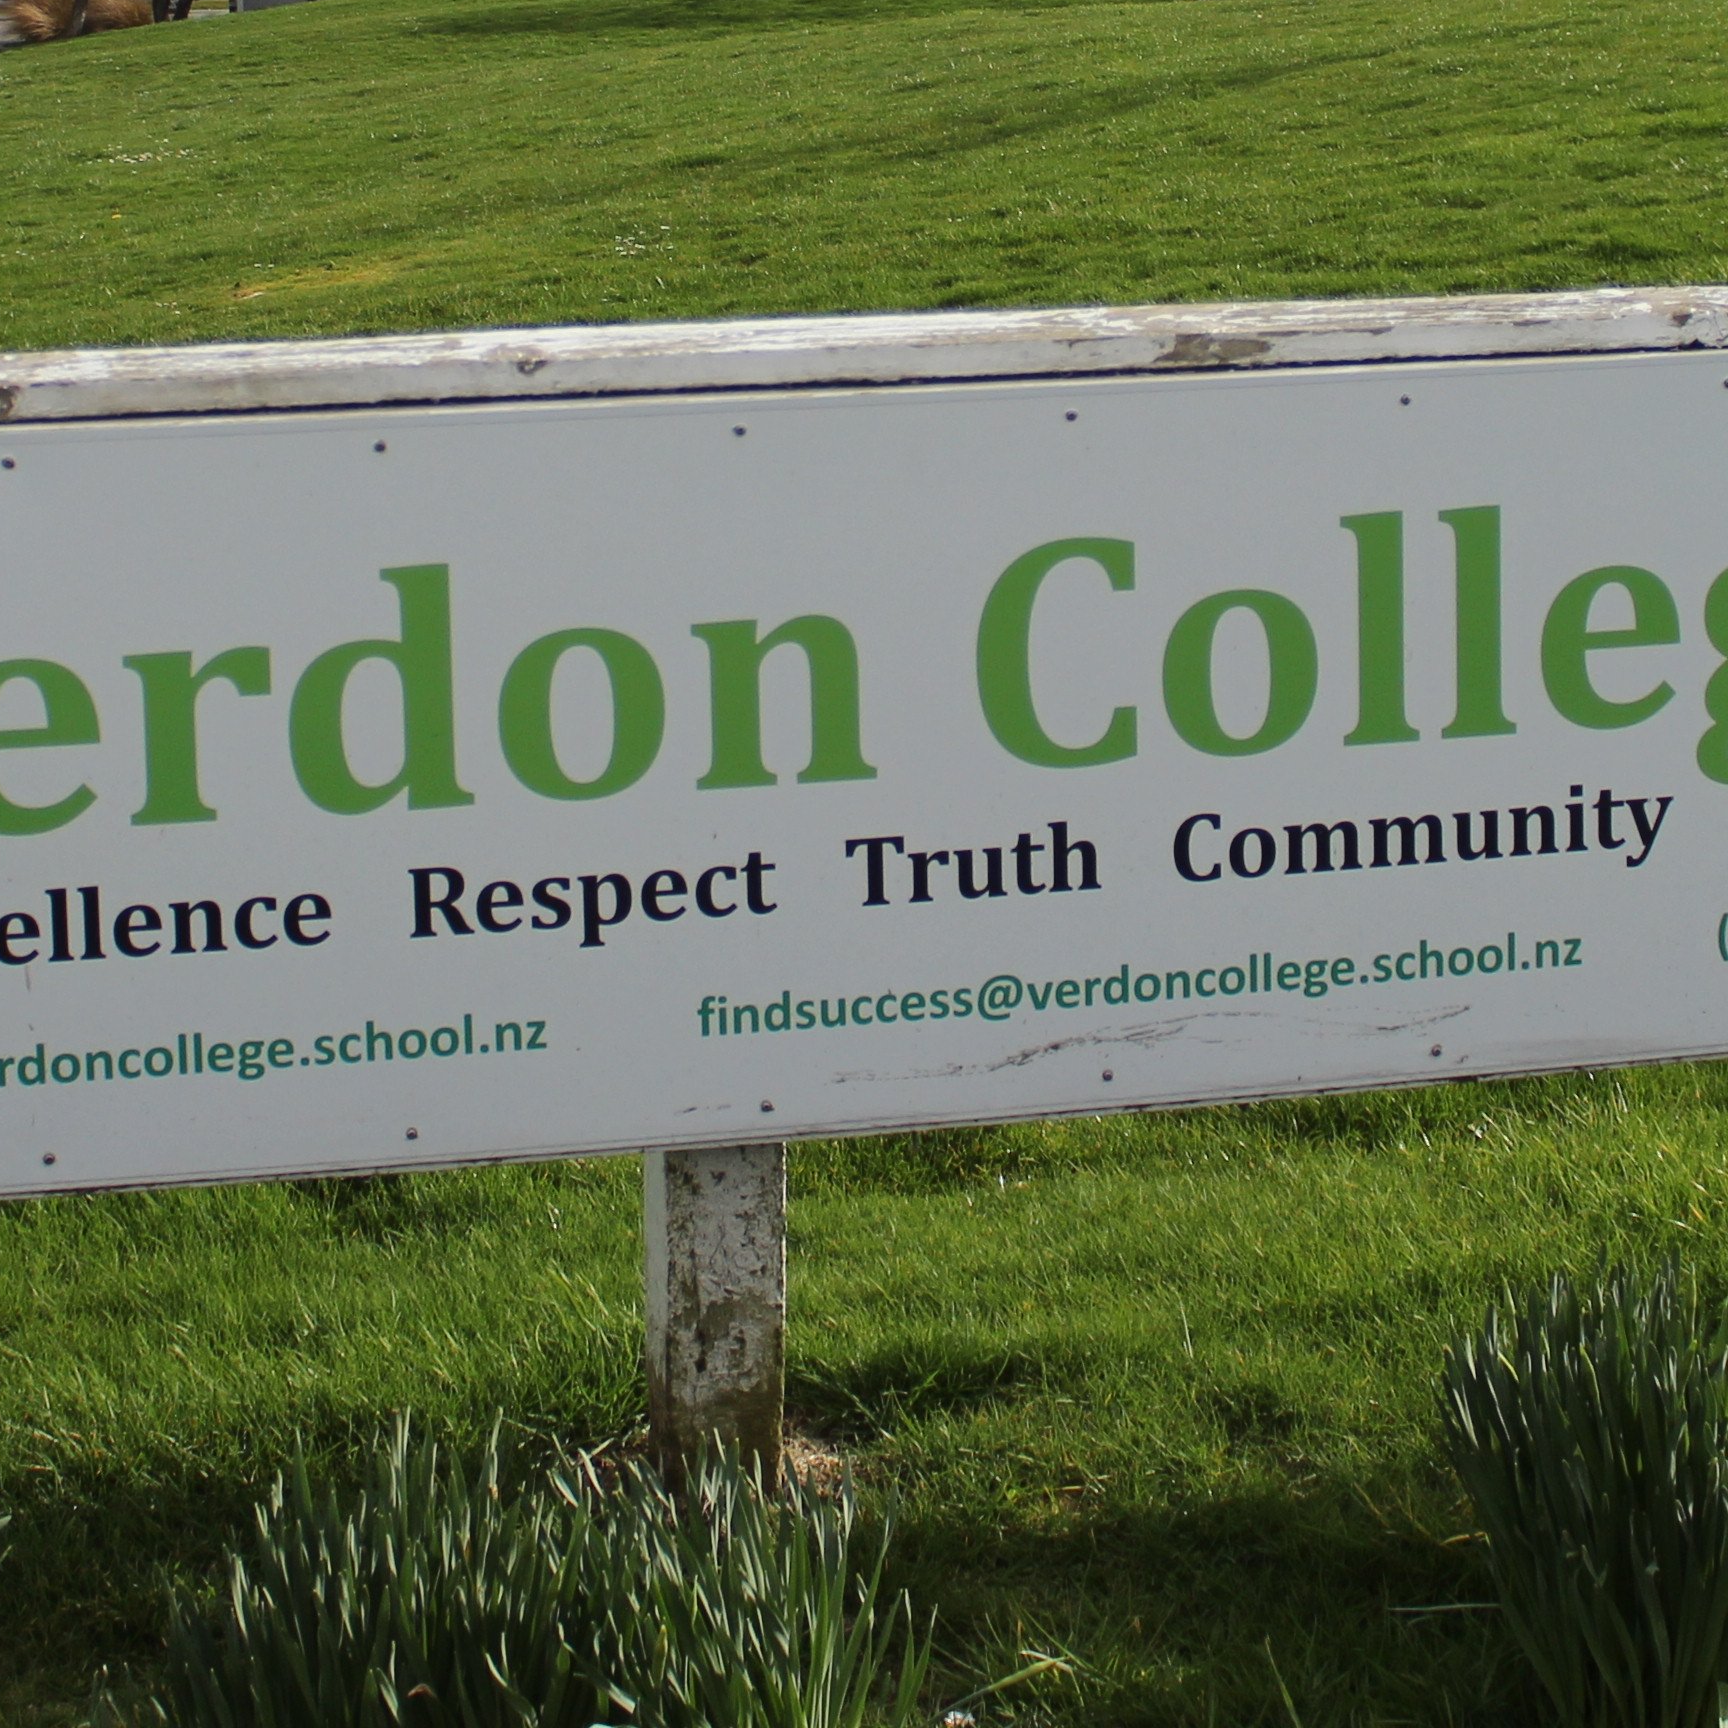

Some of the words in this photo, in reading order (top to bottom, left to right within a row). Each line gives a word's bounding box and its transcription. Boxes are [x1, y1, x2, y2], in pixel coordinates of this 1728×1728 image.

[407, 851, 779, 949] Respect
[844, 820, 1103, 907] Truth
[1172, 788, 1674, 883] Community
[695, 931, 1584, 1038] findsuccess@verdoncollege.school.nz
